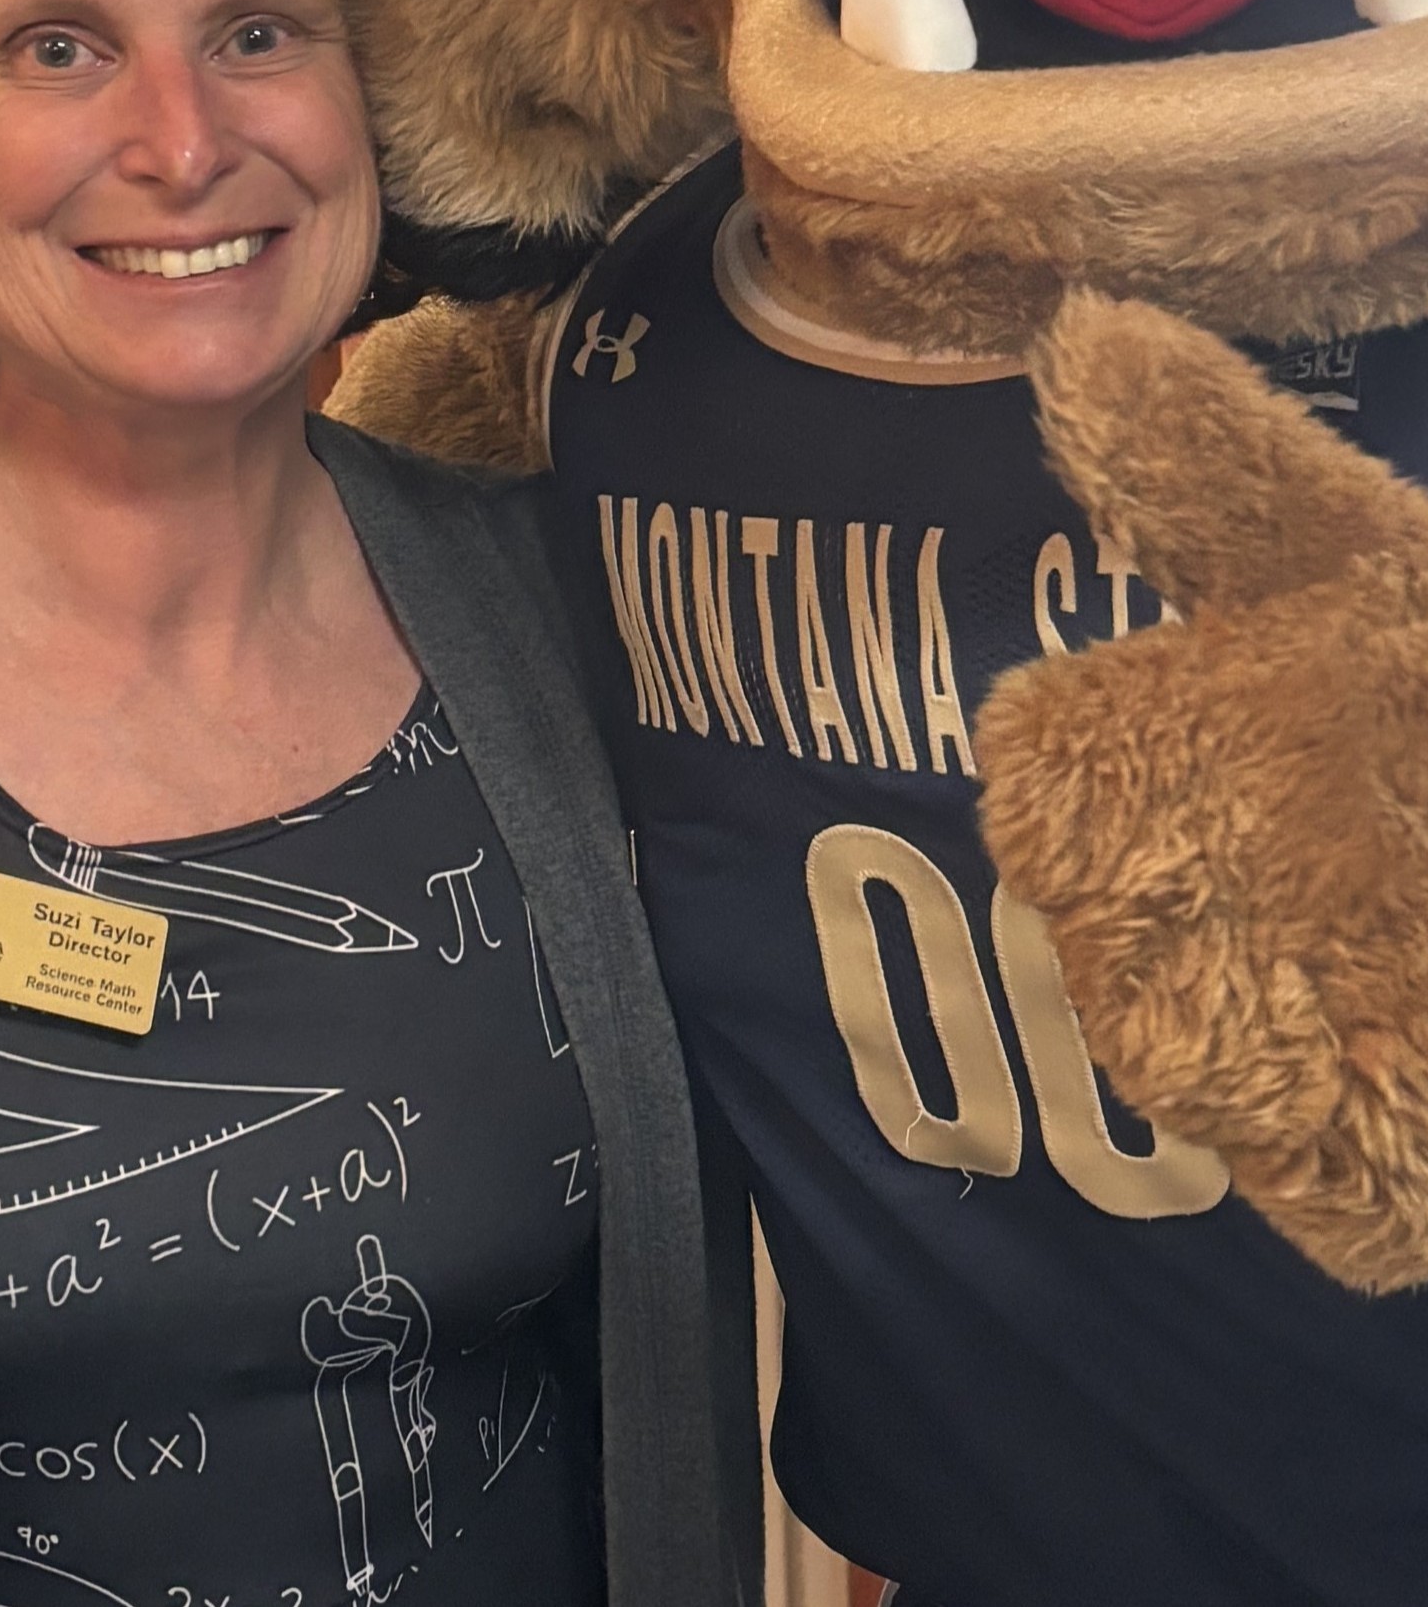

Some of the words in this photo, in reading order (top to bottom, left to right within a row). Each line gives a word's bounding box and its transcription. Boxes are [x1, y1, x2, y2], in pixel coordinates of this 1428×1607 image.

[598, 494, 977, 776] MONTANA
[34, 903, 81, 930] Suzi
[91, 916, 156, 949] Taylor
[48, 931, 131, 966] Director
[26, 975, 91, 1002] Resource
[96, 993, 143, 1016] Center
[39, 964, 94, 988] Science
[100, 979, 137, 999] Math
[806, 823, 1232, 1219] 00
